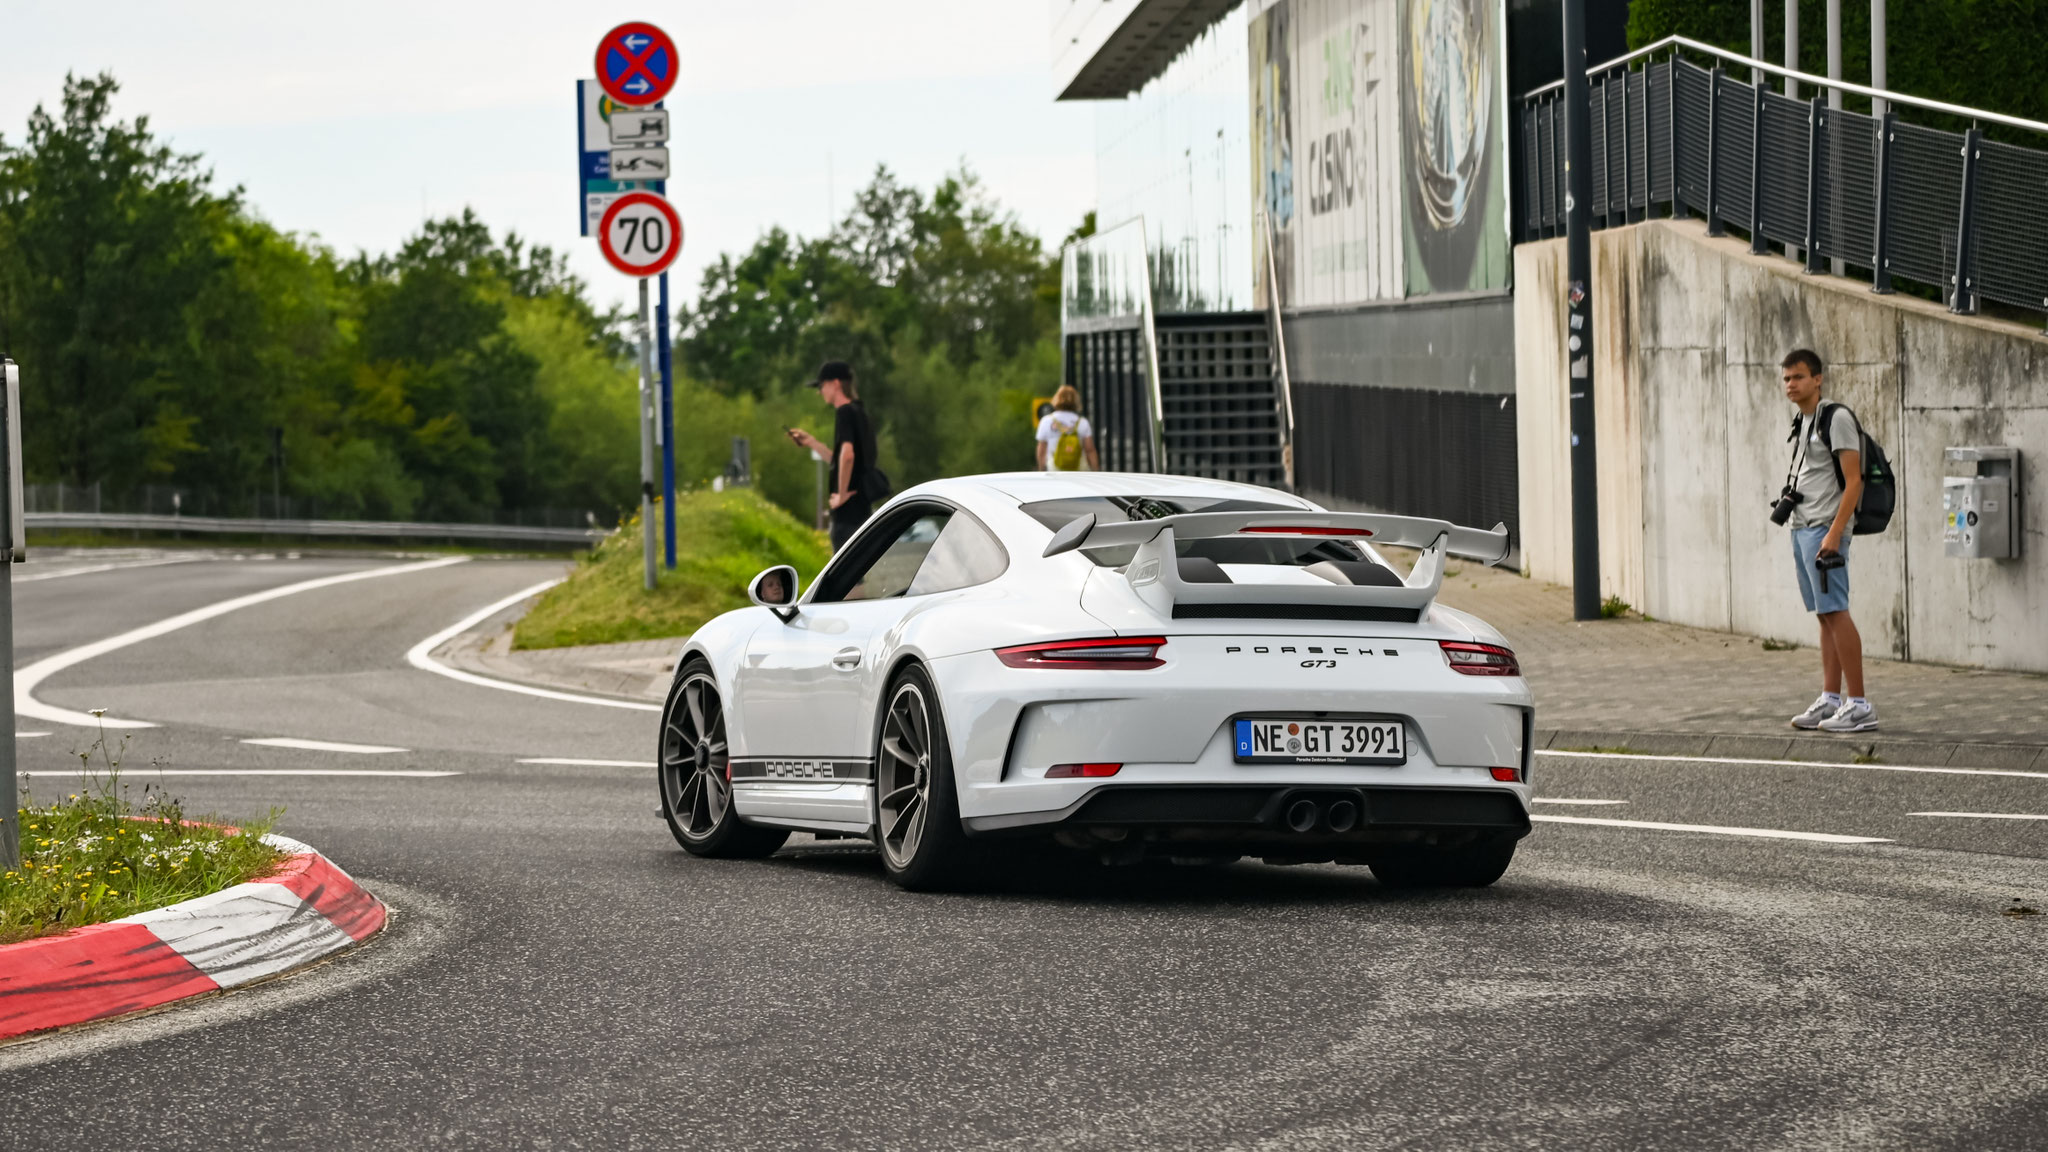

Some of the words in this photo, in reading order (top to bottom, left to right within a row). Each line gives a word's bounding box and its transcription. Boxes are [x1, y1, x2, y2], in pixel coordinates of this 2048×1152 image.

[1310, 127, 1354, 217] CASINO
[618, 216, 664, 254] 70
[1226, 647, 1399, 656] PORSCHE
[1300, 660, 1337, 668] GT3
[1240, 742, 1248, 751] D
[1254, 724, 1285, 752] NE
[1304, 725, 1334, 753] GT
[1340, 725, 1400, 754] 3991
[766, 762, 833, 778] PORSCHE
